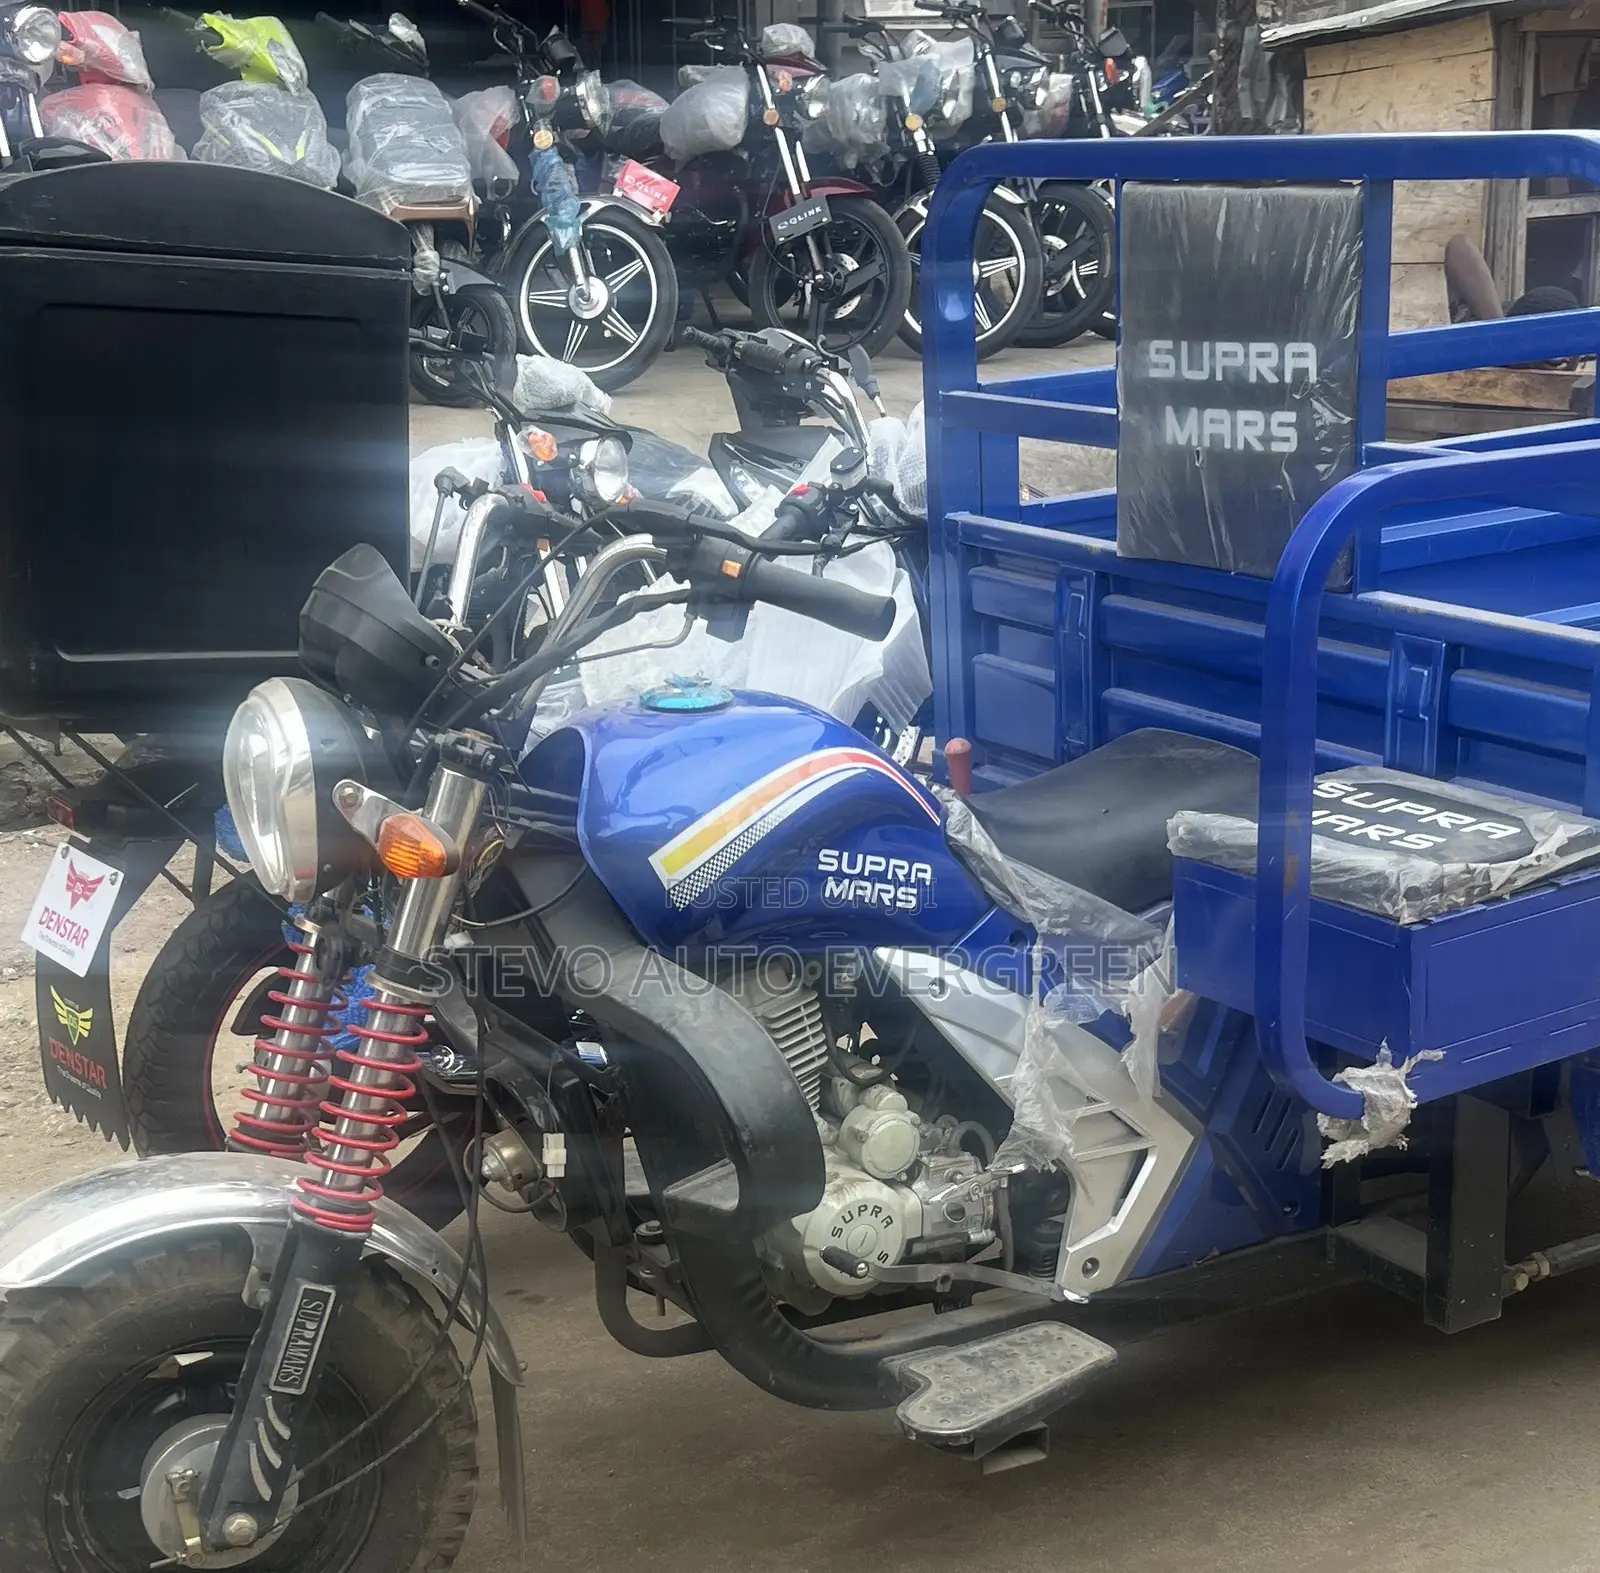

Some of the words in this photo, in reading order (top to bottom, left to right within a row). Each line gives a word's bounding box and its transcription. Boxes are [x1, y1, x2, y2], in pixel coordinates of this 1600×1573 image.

[1149, 339, 1318, 384] SUPRA
[1165, 405, 1298, 453] MARS
[1313, 781, 1521, 840] SUPRA
[817, 848, 932, 886] SUPRA
[824, 876, 917, 909] MARS
[38, 905, 90, 950] DENSTAR
[49, 1036, 107, 1089] DENSTAR
[831, 1204, 894, 1239] SUPRA
[278, 1298, 325, 1385] SUPRAMARS
